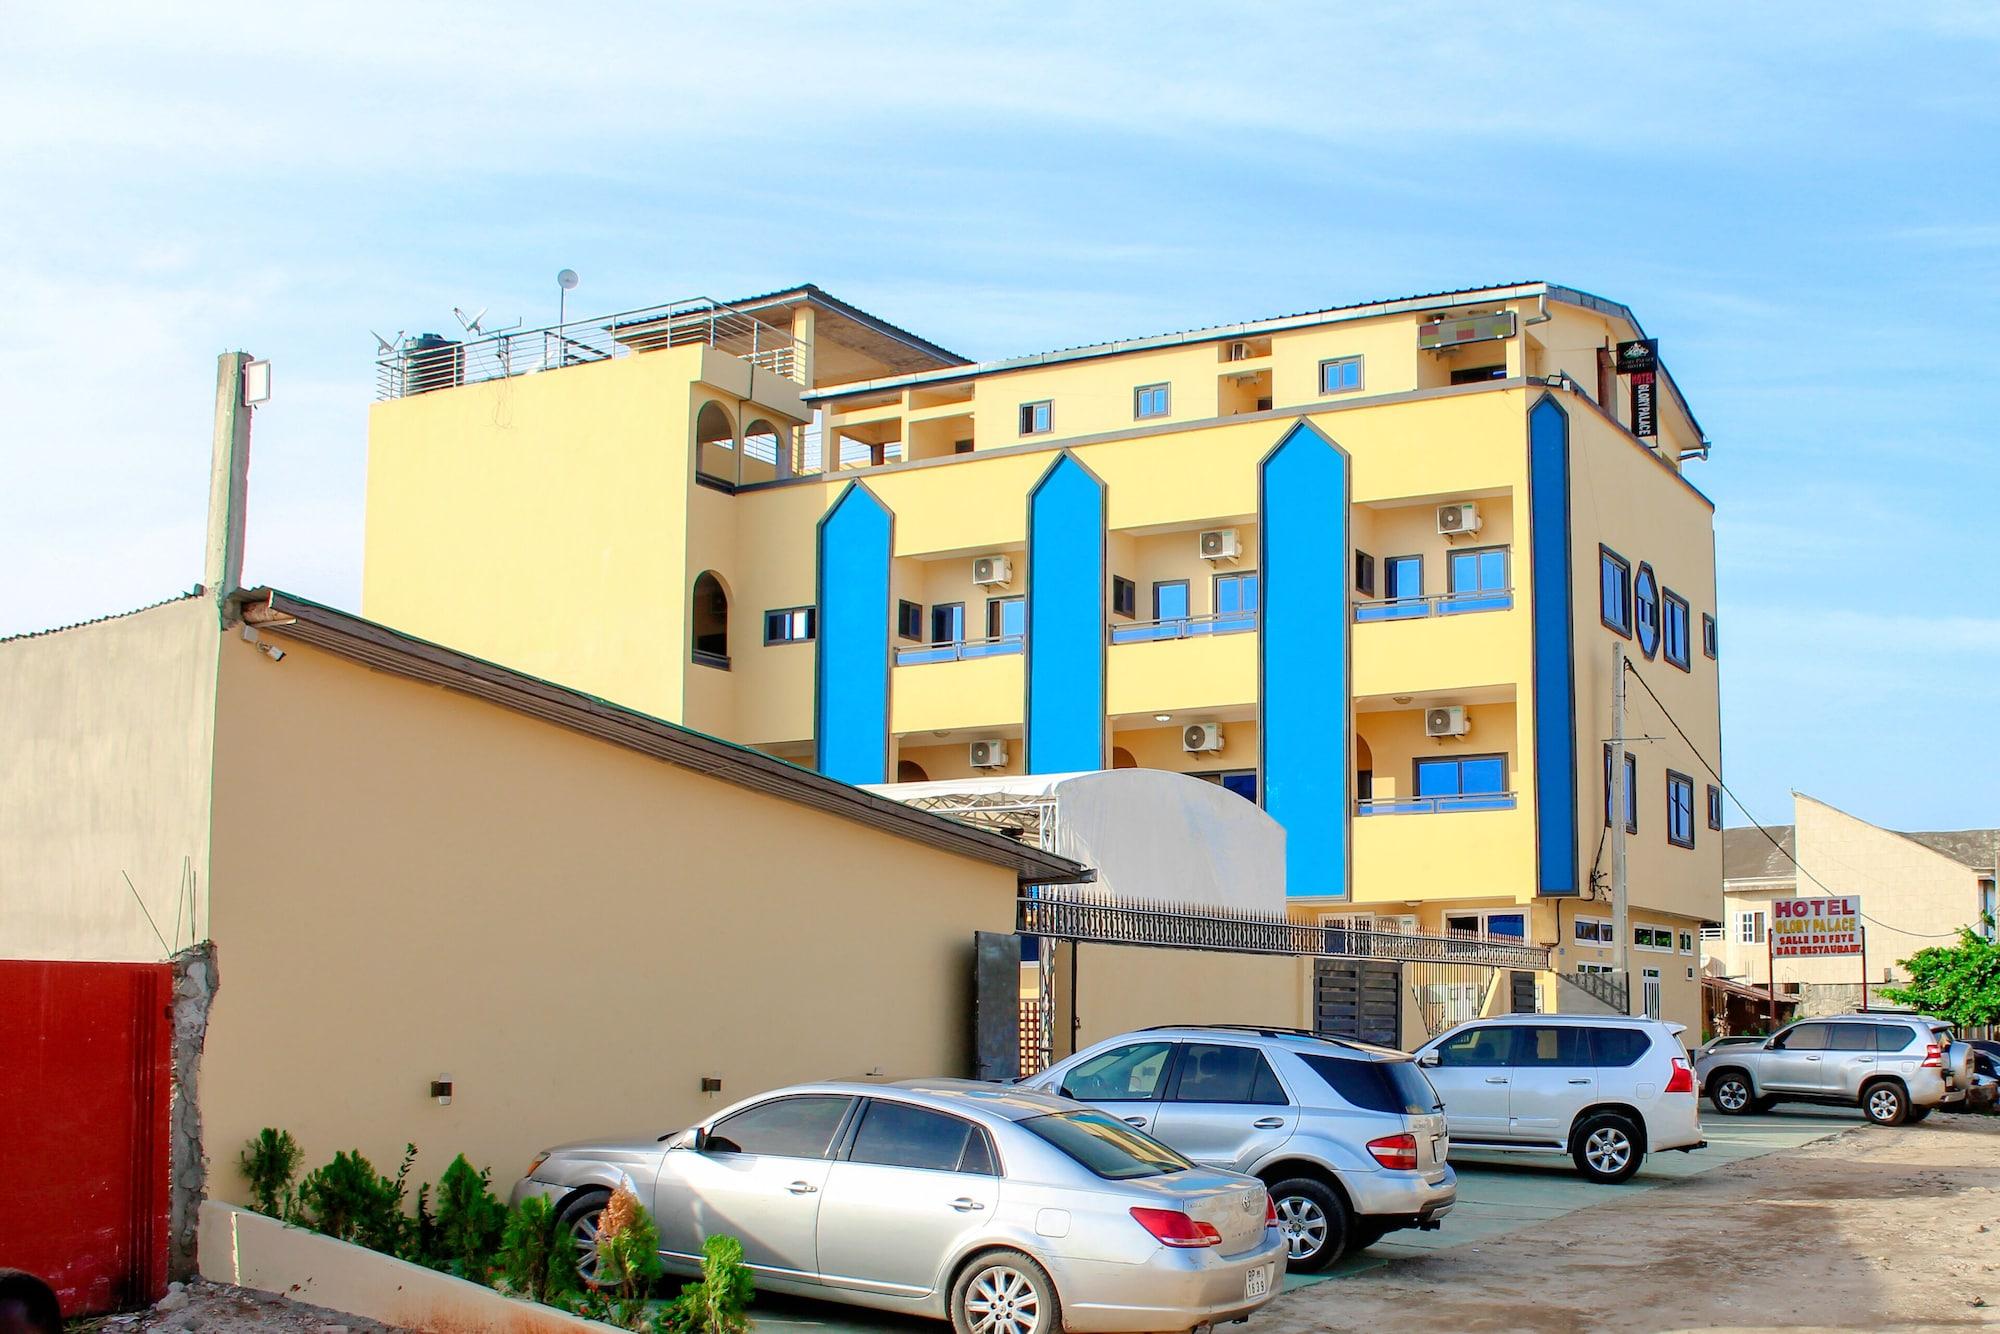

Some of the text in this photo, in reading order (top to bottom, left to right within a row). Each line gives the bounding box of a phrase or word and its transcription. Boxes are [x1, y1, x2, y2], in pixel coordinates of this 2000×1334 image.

[1631, 372, 1654, 385] HOTEL
[1775, 899, 1855, 918] HOTEL
[1775, 917, 1857, 934] GLORY PALACE
[1780, 935, 1809, 945] SALLE
[1776, 946, 1797, 955] BAR
